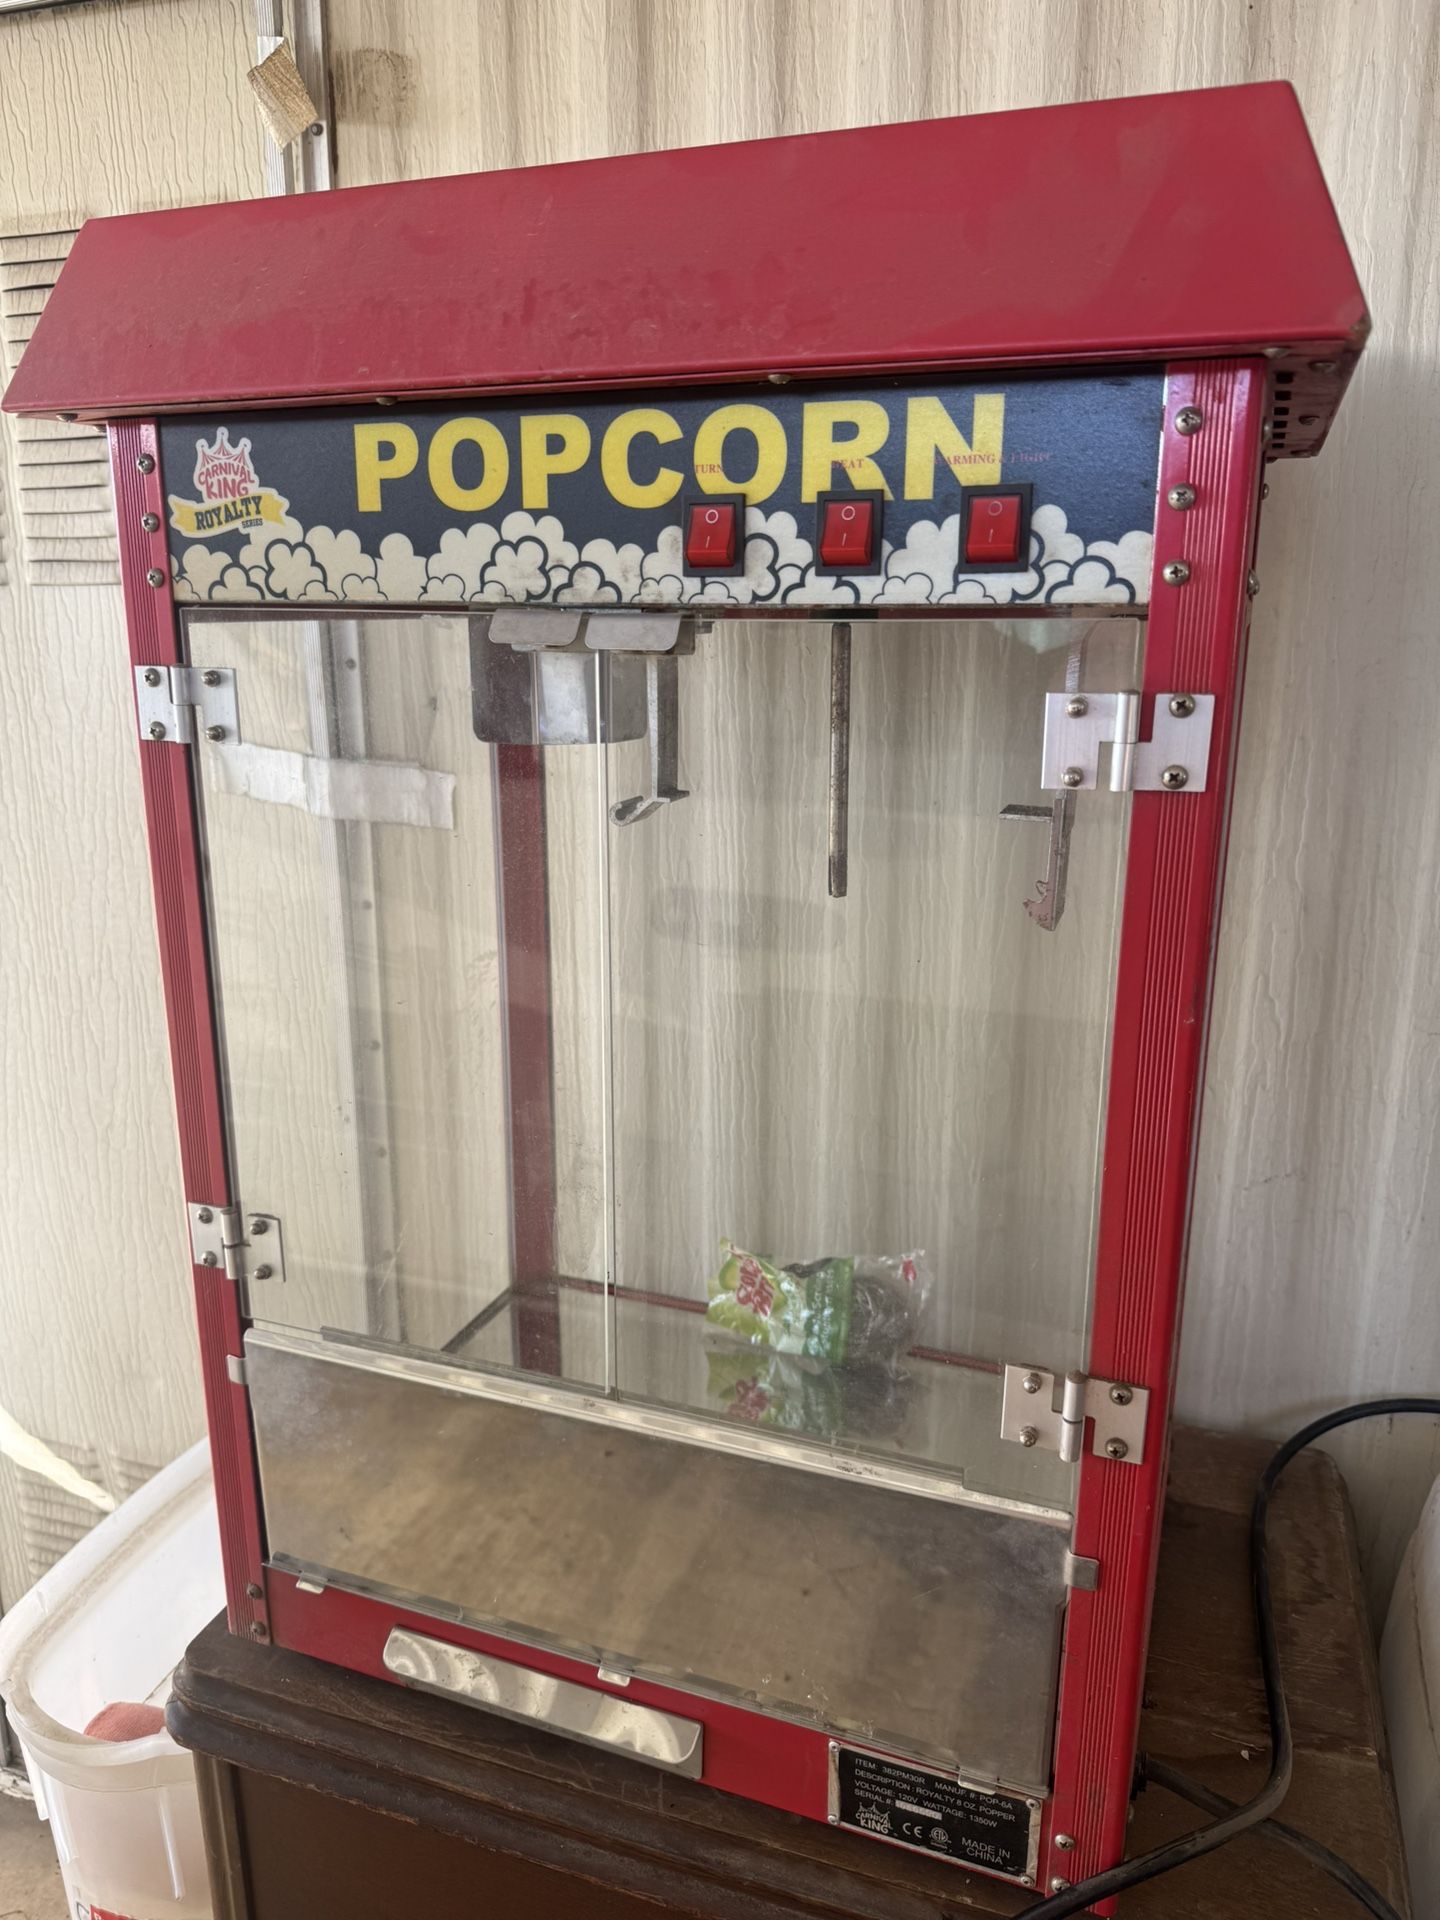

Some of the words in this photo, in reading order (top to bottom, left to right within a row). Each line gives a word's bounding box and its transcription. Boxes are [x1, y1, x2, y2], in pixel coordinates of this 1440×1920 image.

[353, 393, 1006, 513] POPCORN
[832, 458, 865, 469] HEAT
[935, 453, 996, 465] ARMING
[198, 461, 255, 486] CARNIVAL
[694, 463, 723, 474] TURN
[206, 477, 249, 500] KING
[195, 495, 263, 531] ROYALTY
[241, 518, 264, 529] SERIES
[855, 1757, 878, 1769] ITEM:
[882, 1766, 926, 1784] 382PM30R
[854, 1768, 911, 1791] DESCRIPTION
[916, 1786, 955, 1804] ROYALTY
[979, 1805, 1016, 1822] POPPER
[854, 1788, 885, 1803] SERIAL
[854, 1780, 896, 1797] VOLTAGE:
[898, 1792, 919, 1804] 120V
[922, 1800, 967, 1819] WATTAGE:
[855, 1811, 893, 1830] CARNIVAL
[860, 1819, 889, 1834] KING
[961, 1836, 996, 1854] MADE
[999, 1848, 1011, 1859] IN
[966, 1847, 1003, 1865] CHINA
